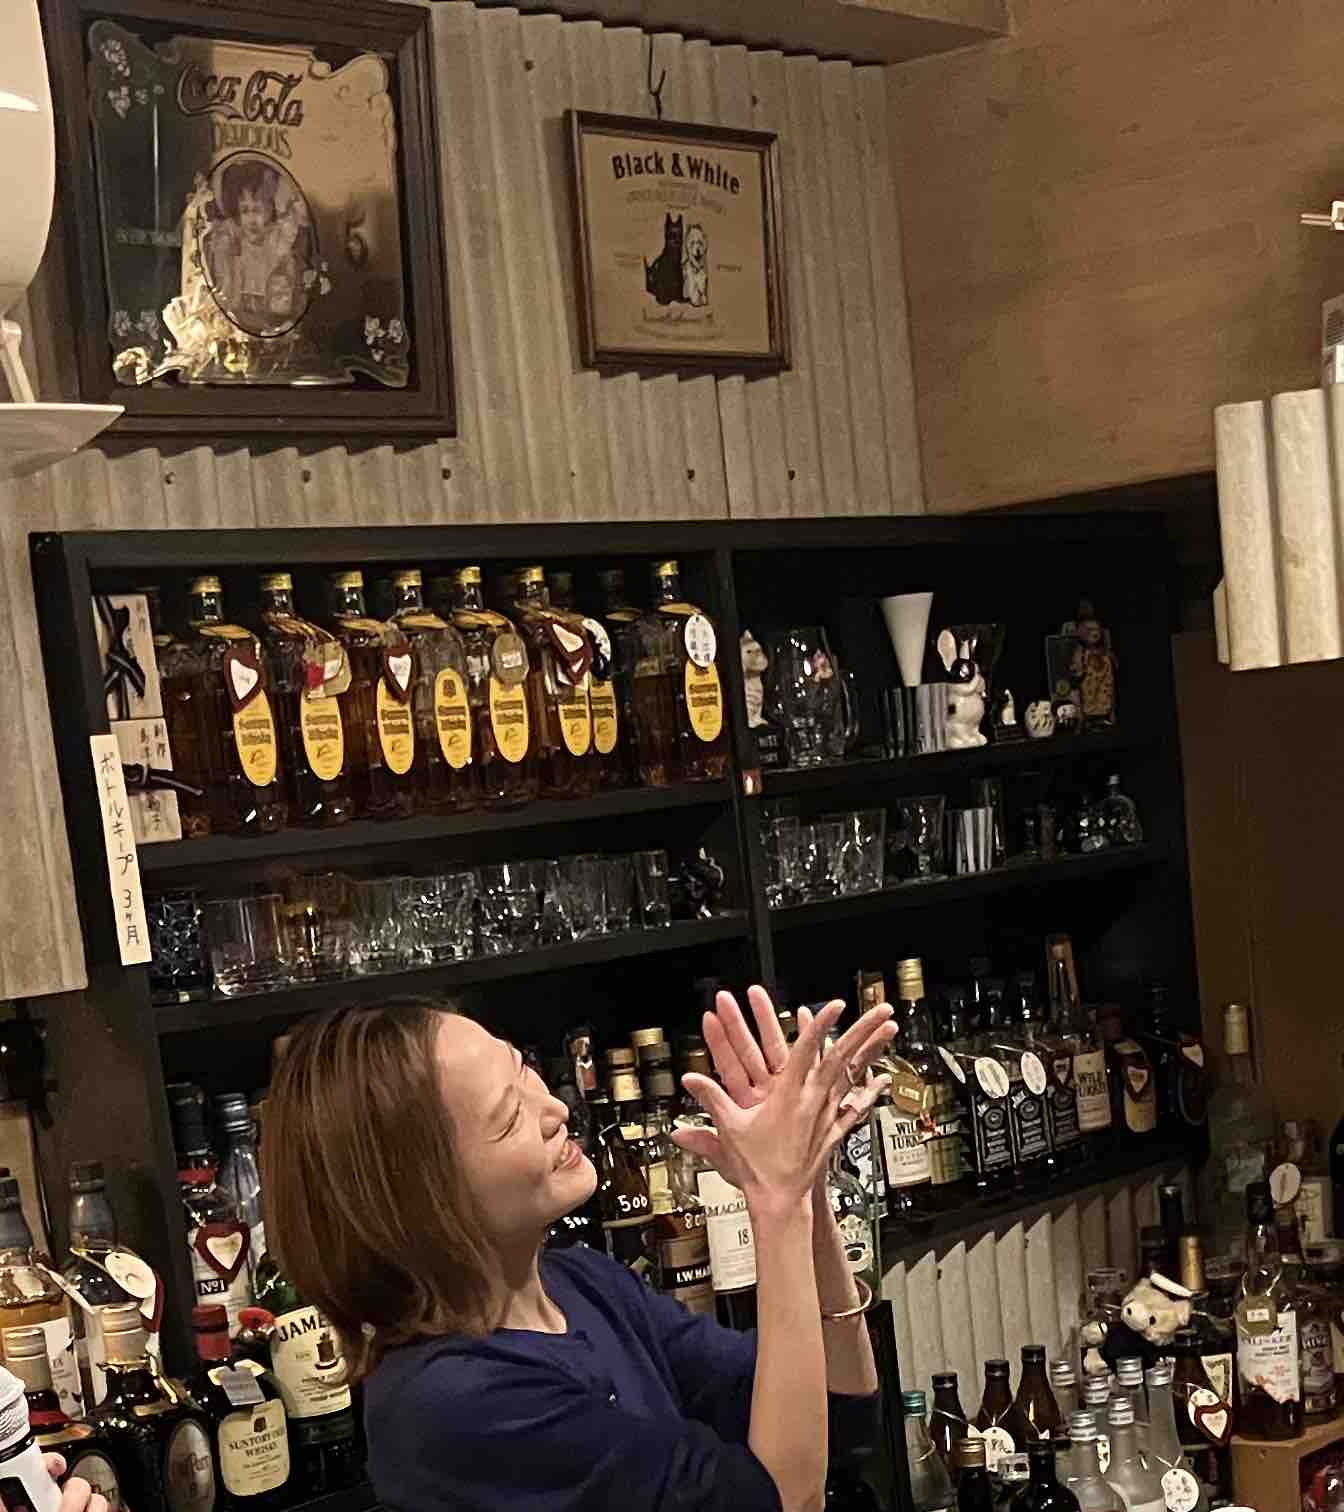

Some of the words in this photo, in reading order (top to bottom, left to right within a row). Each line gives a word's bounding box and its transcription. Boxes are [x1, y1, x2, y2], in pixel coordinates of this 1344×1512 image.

[612, 152, 665, 179] Black
[671, 152, 684, 177] &
[686, 155, 740, 194] White
[895, 1119, 922, 1134] WIL
[617, 1194, 648, 1212] 500
[738, 1229, 750, 1246] 18
